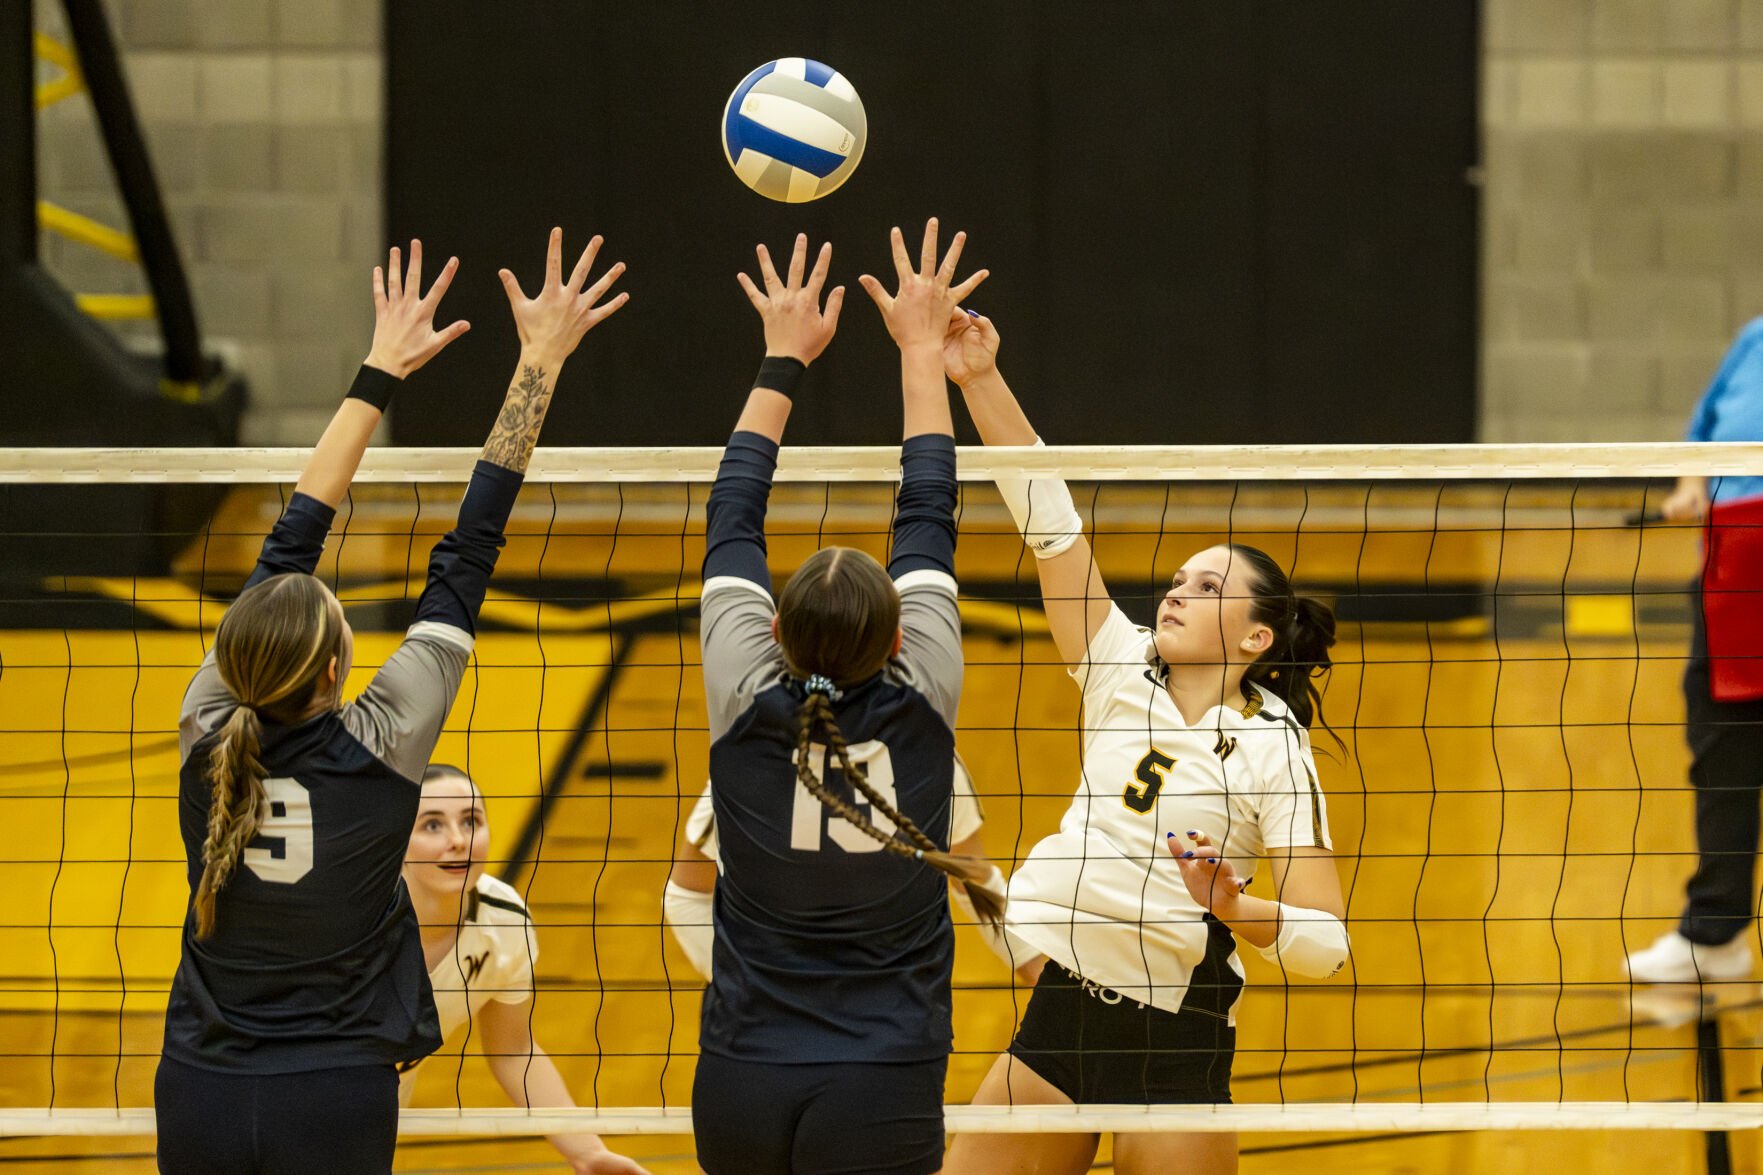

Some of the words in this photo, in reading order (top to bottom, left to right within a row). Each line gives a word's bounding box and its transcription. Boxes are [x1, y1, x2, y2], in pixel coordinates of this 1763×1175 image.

[791, 739, 898, 853] 13
[1122, 745, 1178, 816] 5
[244, 777, 313, 884] 9
[464, 951, 490, 983] W
